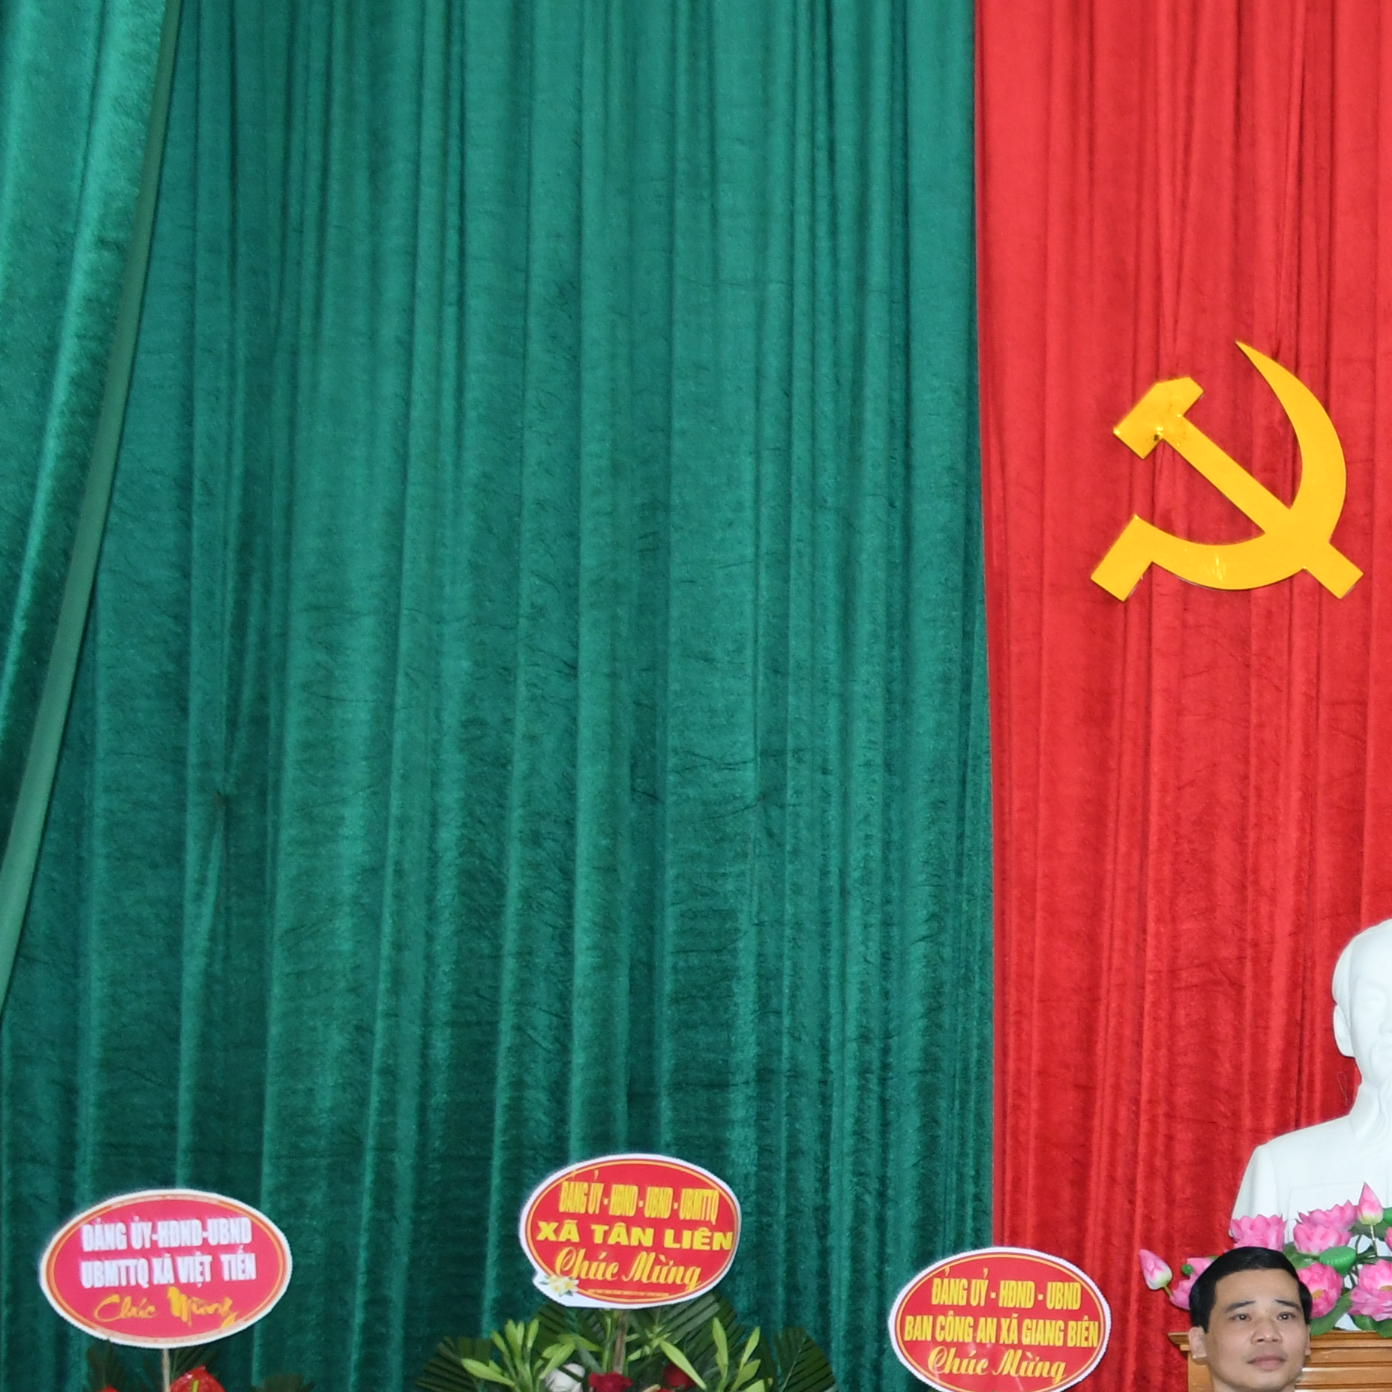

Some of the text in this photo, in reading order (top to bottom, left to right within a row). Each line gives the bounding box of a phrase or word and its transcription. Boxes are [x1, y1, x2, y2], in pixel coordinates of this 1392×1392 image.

[536, 1218, 734, 1251] XÃ TÂN LIÊN
[152, 1253, 175, 1285] XÃ
[176, 1251, 213, 1288] VIỆT
[219, 1245, 257, 1281] TIẾN
[555, 1247, 702, 1290] Chúc Mừng
[931, 1267, 968, 1307] ĐẢNG
[1046, 1281, 1082, 1310] UBND
[904, 1310, 1099, 1348] BAN CÔNG AN XÃ GIANG BIÊN
[927, 1346, 1066, 1385] Chúc Mừng
